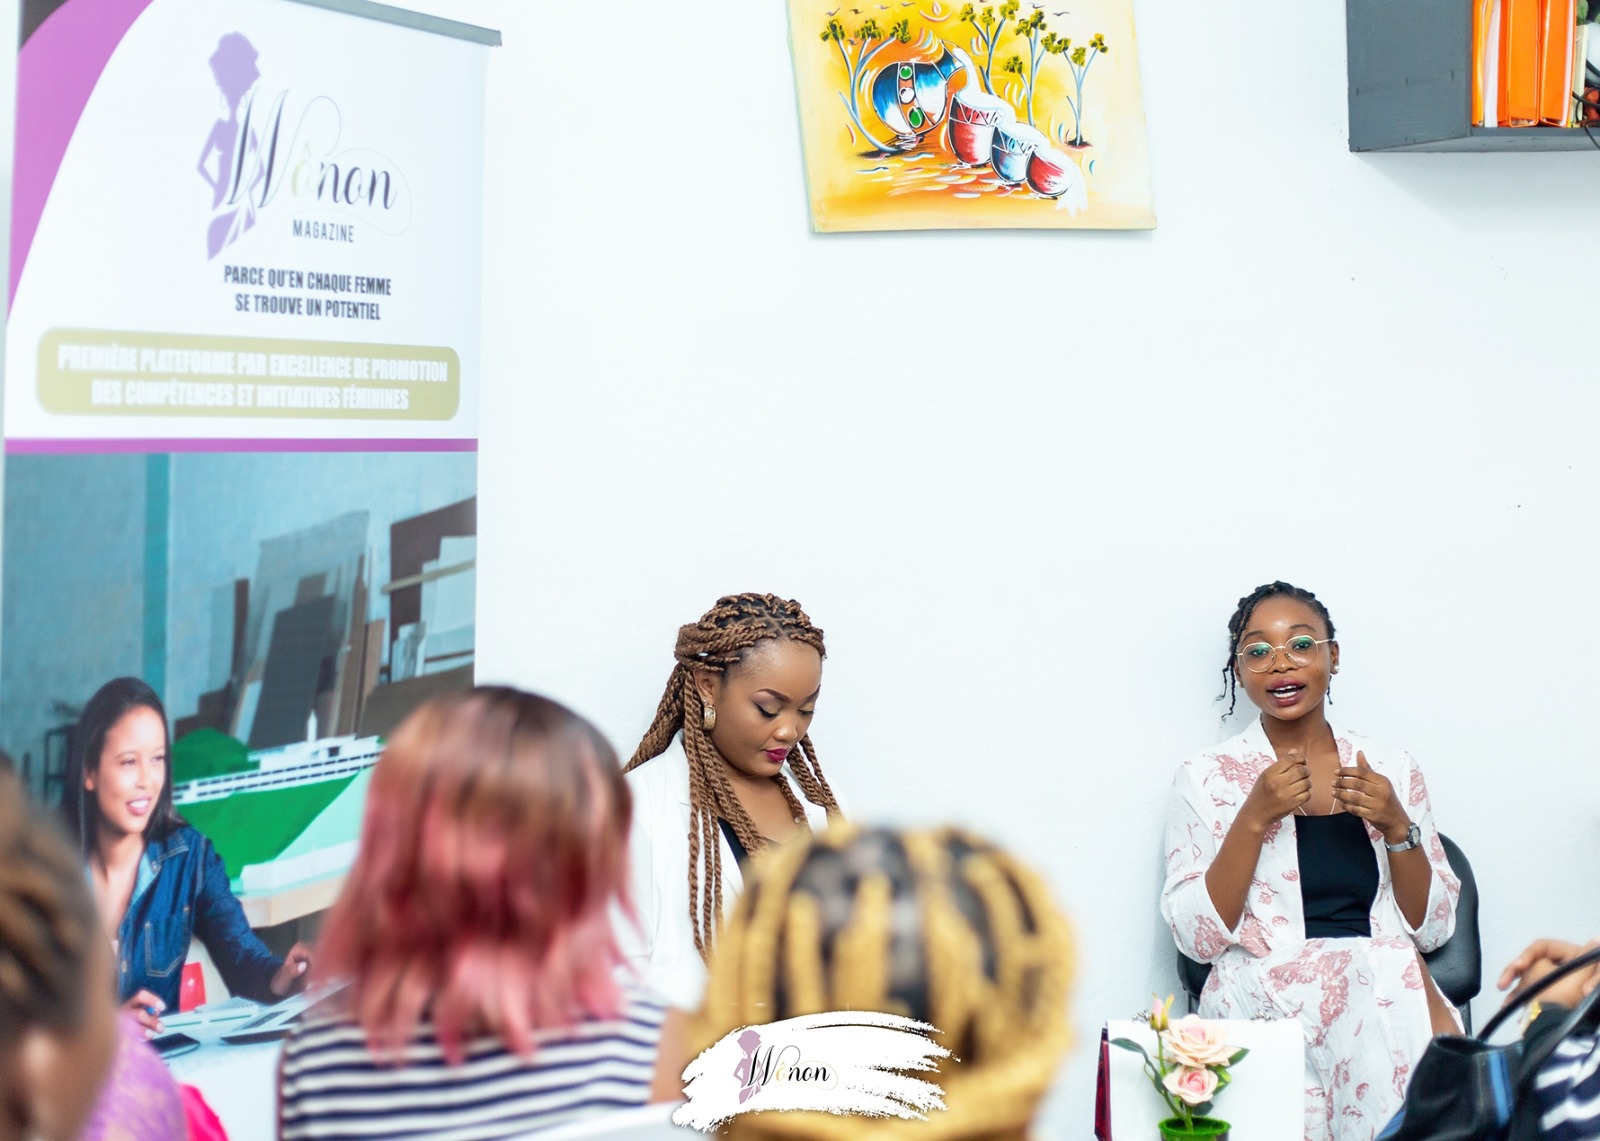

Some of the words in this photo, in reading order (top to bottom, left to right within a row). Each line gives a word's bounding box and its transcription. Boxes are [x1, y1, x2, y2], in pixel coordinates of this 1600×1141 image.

[293, 219, 354, 243] MAGAZINE
[224, 265, 264, 285] PARCE
[268, 268, 304, 289] QU'EN
[307, 271, 352, 293] CHAQUE
[355, 276, 392, 296] FEMME
[235, 293, 250, 312] SE
[253, 294, 303, 315] TROUVE
[306, 298, 322, 316] UN
[325, 300, 381, 320] POTENTIEL
[57, 342, 138, 371] PREMIÈRE
[140, 348, 235, 375] PLATEFORME
[237, 352, 267, 376] PAR
[269, 354, 351, 378] EXCELLENCE
[353, 357, 370, 379] DE
[372, 358, 448, 382] PROMOTION
[91, 379, 122, 405] DES
[124, 378, 235, 407] COMPÉTENCES
[237, 383, 255, 406] ET
[257, 385, 341, 408] INITIATIVES
[342, 384, 409, 410] FÉMININES
